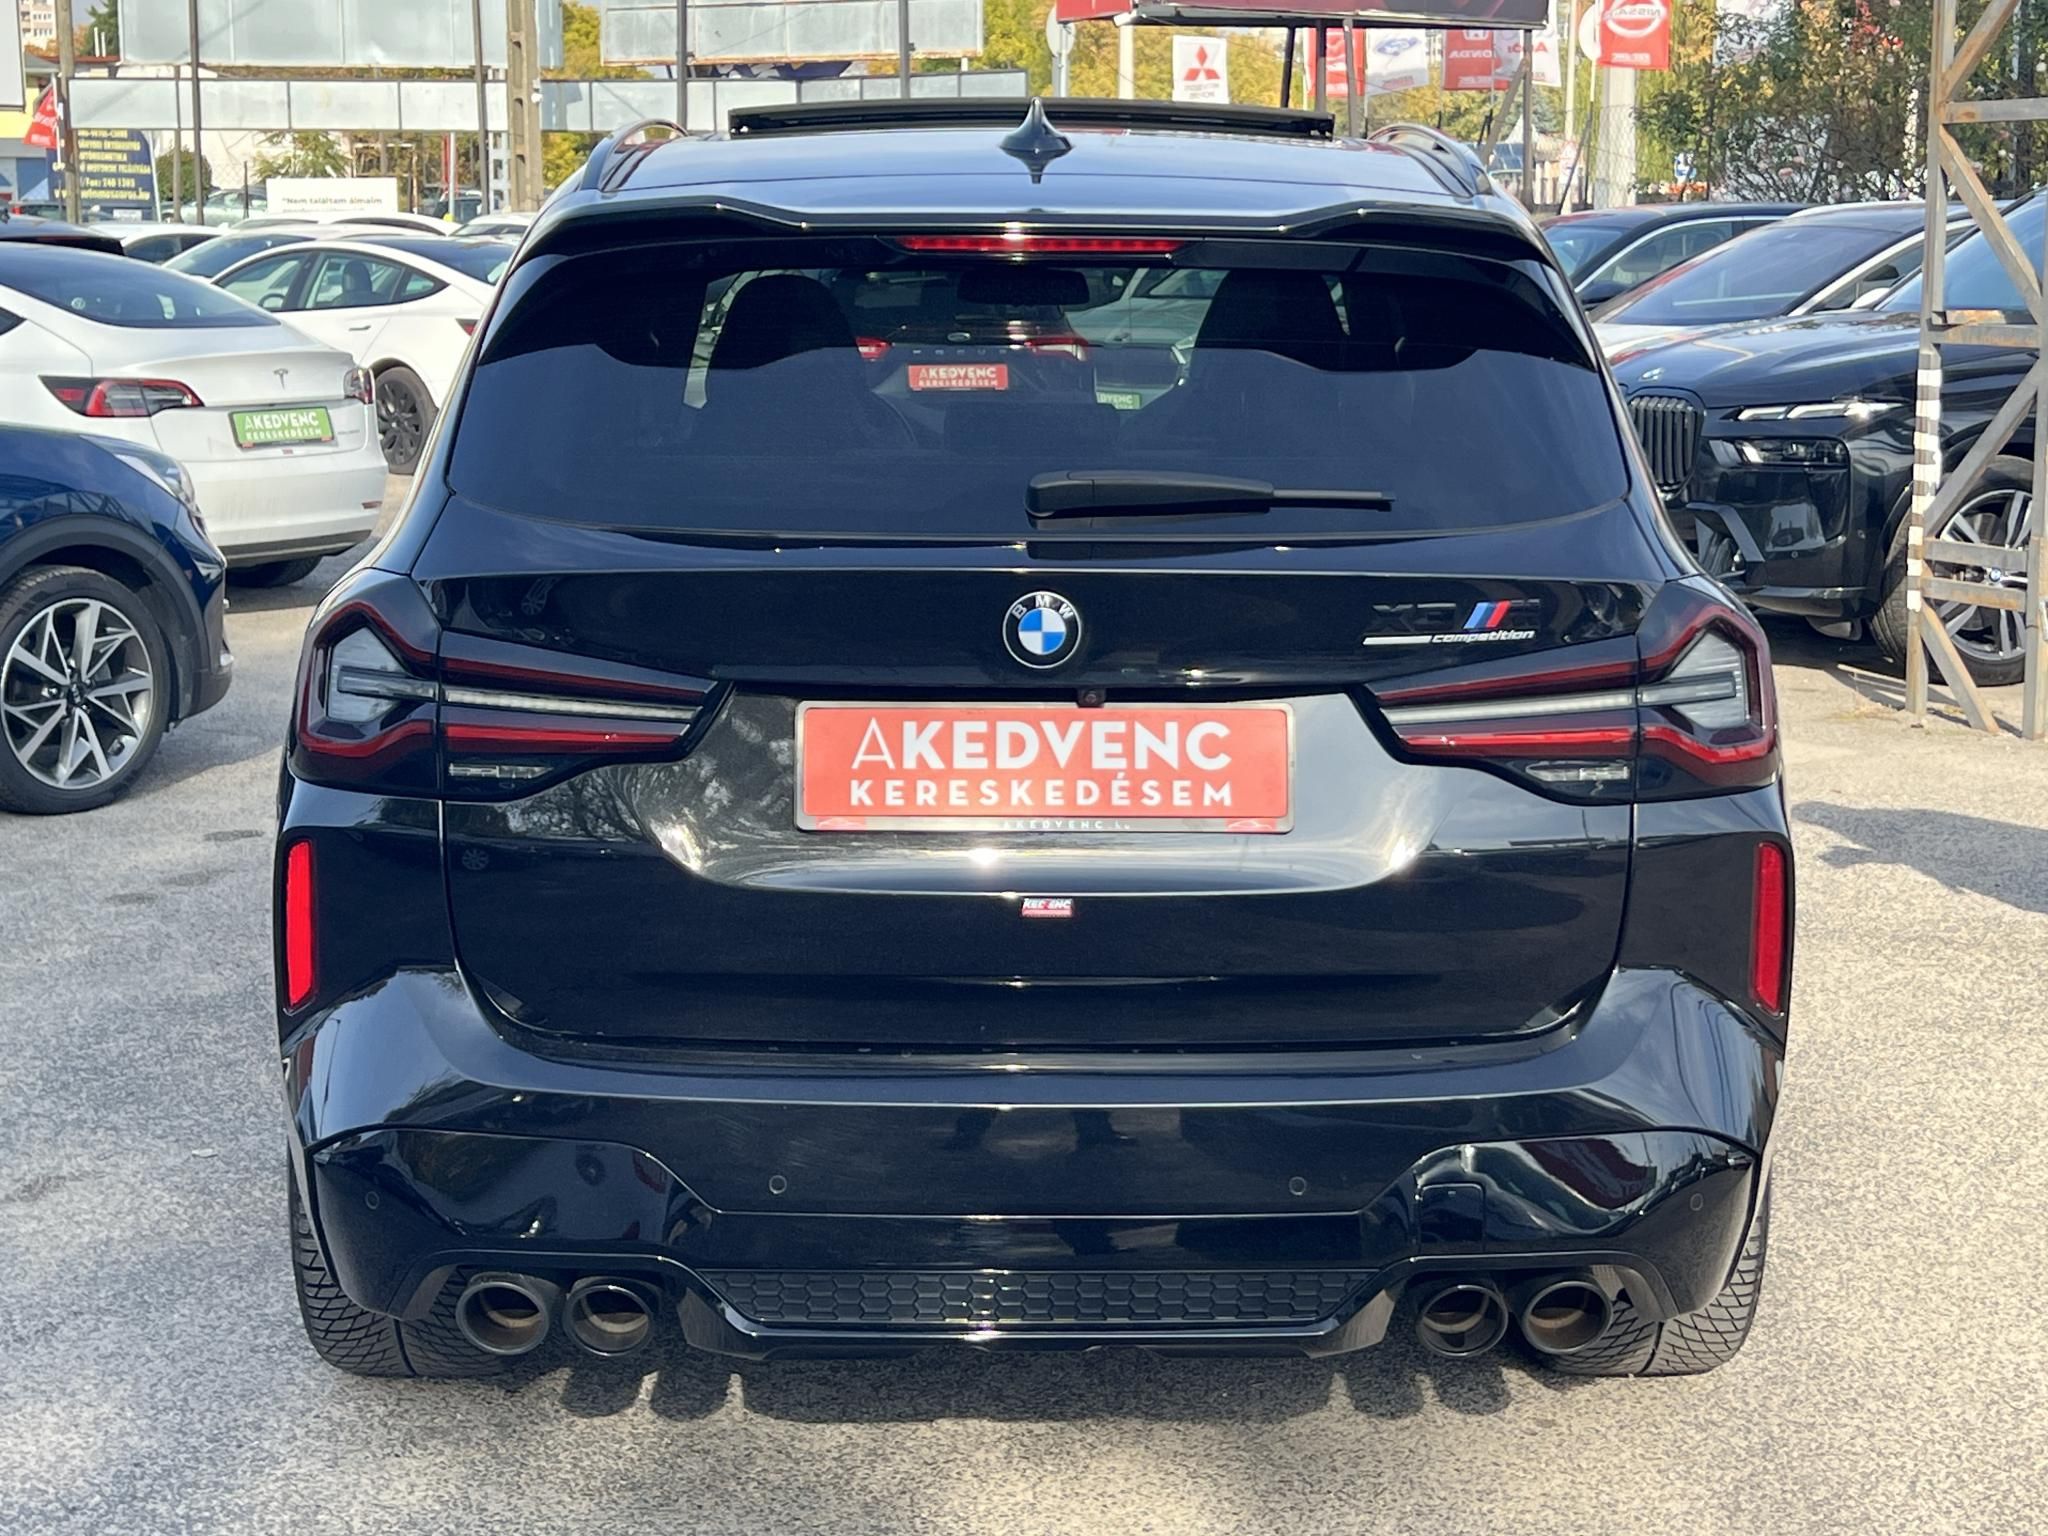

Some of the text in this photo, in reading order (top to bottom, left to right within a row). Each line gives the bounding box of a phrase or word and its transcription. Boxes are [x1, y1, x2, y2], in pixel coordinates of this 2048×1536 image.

[920, 366, 997, 379] AKEDVENC
[244, 411, 319, 430] AKEDVENC
[1012, 594, 1074, 620] BMW
[1431, 629, 1536, 644] competition
[852, 716, 1233, 771] AKEDVENC
[850, 772, 1233, 808] KERESKEDÉSEM
